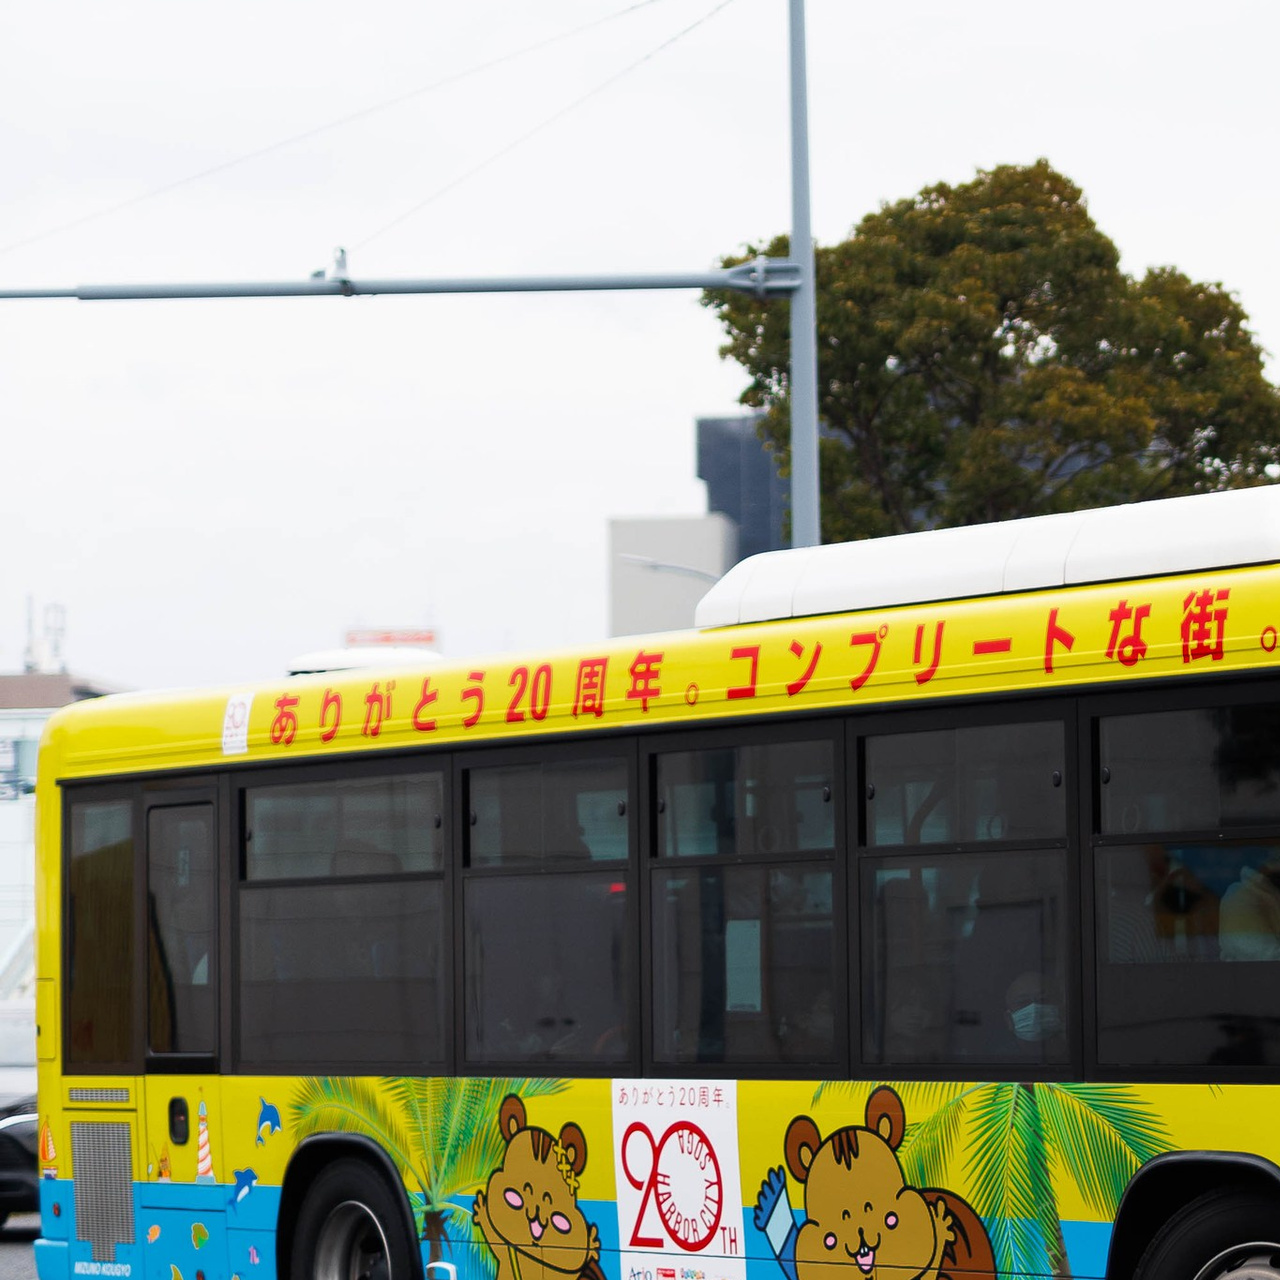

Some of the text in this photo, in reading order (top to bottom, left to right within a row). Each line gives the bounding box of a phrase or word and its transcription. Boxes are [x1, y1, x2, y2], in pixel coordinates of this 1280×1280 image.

[677, 1129, 712, 1171] SOGA
[657, 1172, 700, 1244] HARBOR
[700, 1178, 719, 1231] CITY
[720, 1226, 738, 1255] TH
